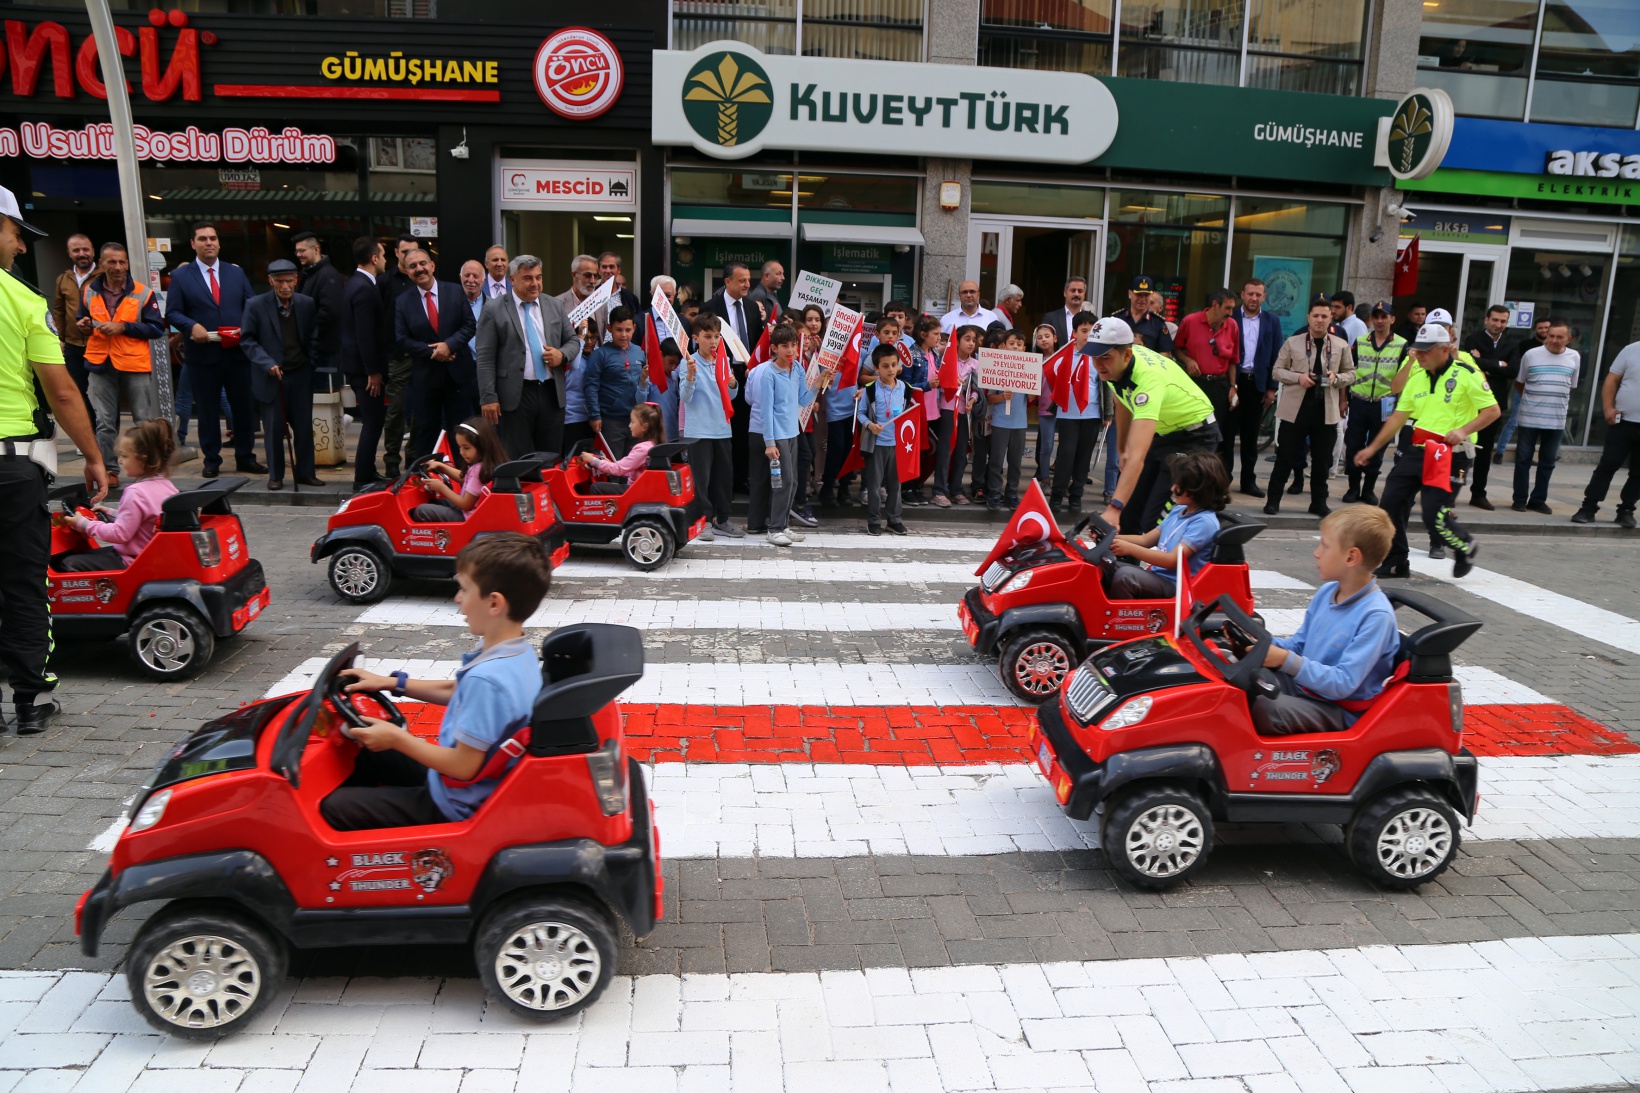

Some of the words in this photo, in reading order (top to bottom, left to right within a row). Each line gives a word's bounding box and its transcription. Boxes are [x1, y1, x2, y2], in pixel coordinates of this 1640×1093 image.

[0, 8, 201, 102] ncü
[1254, 121, 1364, 148] GÜMÜŞHANE
[20, 121, 119, 159] Usulü
[133, 124, 220, 161] Soslu
[222, 127, 336, 163] Dürüm
[1548, 149, 1640, 180] aksa
[536, 177, 604, 195] MESCİD
[1538, 183, 1632, 198] ELEKTRİK
[1434, 221, 1469, 233] aksa
[715, 248, 765, 263] İşlematik
[833, 244, 879, 260] İşlematik
[810, 286, 823, 296] GEÇ
[798, 292, 829, 306] YAŞAMAYI
[1003, 354, 1038, 363] BAYRAKLARLA
[997, 369, 1037, 380] GEÇİTLERİNDE
[62, 580, 91, 588] BLACK
[1117, 609, 1145, 617] BLACK
[1271, 750, 1310, 761] BLACK
[1266, 772, 1309, 780] THUNDER
[351, 851, 408, 867] BLACK
[350, 879, 412, 892] THUNDER
